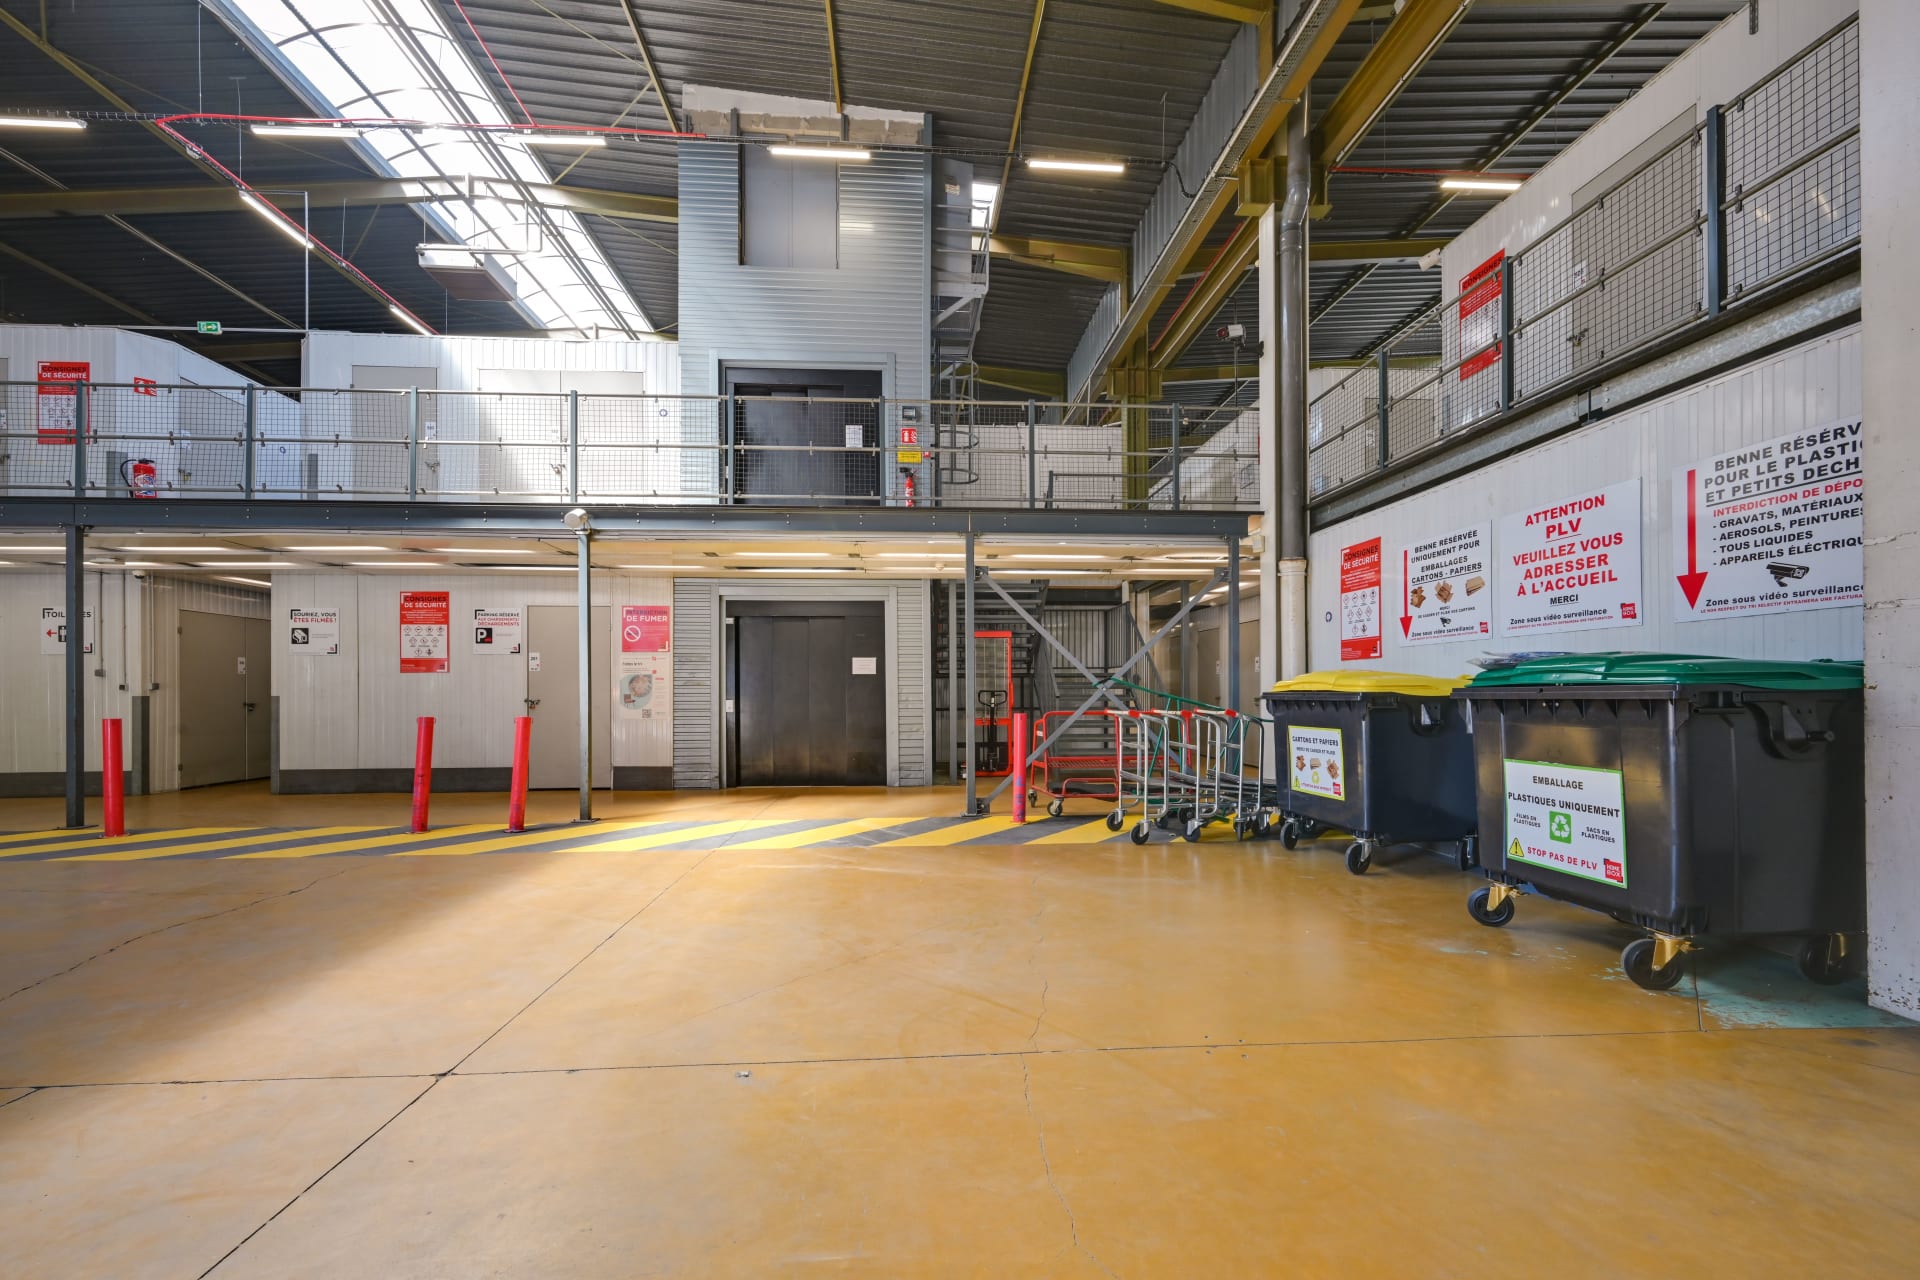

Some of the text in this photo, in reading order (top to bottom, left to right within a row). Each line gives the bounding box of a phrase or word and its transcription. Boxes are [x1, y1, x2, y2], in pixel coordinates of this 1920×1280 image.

[1704, 440, 1863, 488] POUR LE PLASTI
[1714, 446, 1773, 472] BENNE
[1706, 457, 1860, 503] ET PETITS DECH
[1714, 478, 1863, 517] INTERDICTION DE DÉPO
[1526, 494, 1605, 526] ATTENTION
[1720, 510, 1778, 529] GRAVATS,
[1782, 492, 1863, 516] MATÉRIAUX
[1546, 518, 1582, 539] PLV
[1720, 522, 1785, 542] AEROSOLS,
[1344, 544, 1378, 561] CONSIGNES
[1411, 540, 1480, 564] UNIQUEMENT POUR
[1414, 542, 1437, 554] BENNE
[1513, 532, 1623, 566] VEUILLEZ VOUS
[1720, 539, 1750, 554] TOUS
[1754, 530, 1814, 548] LIQUIDES
[1344, 553, 1378, 570] DE SÉCURITÉ
[1421, 556, 1468, 572] EMBALLAGES
[1524, 554, 1608, 580] ADRESSER
[1720, 549, 1784, 566] APPAREILS
[1412, 571, 1444, 584] CARTONS
[1450, 562, 1482, 576] PAPIERS
[1517, 570, 1618, 596] À L'ACCUEIL
[1550, 594, 1578, 605] MERCI
[1706, 596, 1729, 607] Zone
[1732, 594, 1756, 604] sous
[1760, 589, 1788, 601] vidéo
[1544, 613, 1561, 621] vidéo
[1564, 608, 1607, 618] surveillance
[1532, 776, 1583, 790] EMBALLAGE
[1508, 792, 1620, 818] PLASTIQUES UNIQUEMENT
[1514, 818, 1541, 828] PLASTIQUES
[1581, 832, 1616, 843] PLASTIQUES
[1527, 847, 1598, 870] STOP PAS DE PLV
